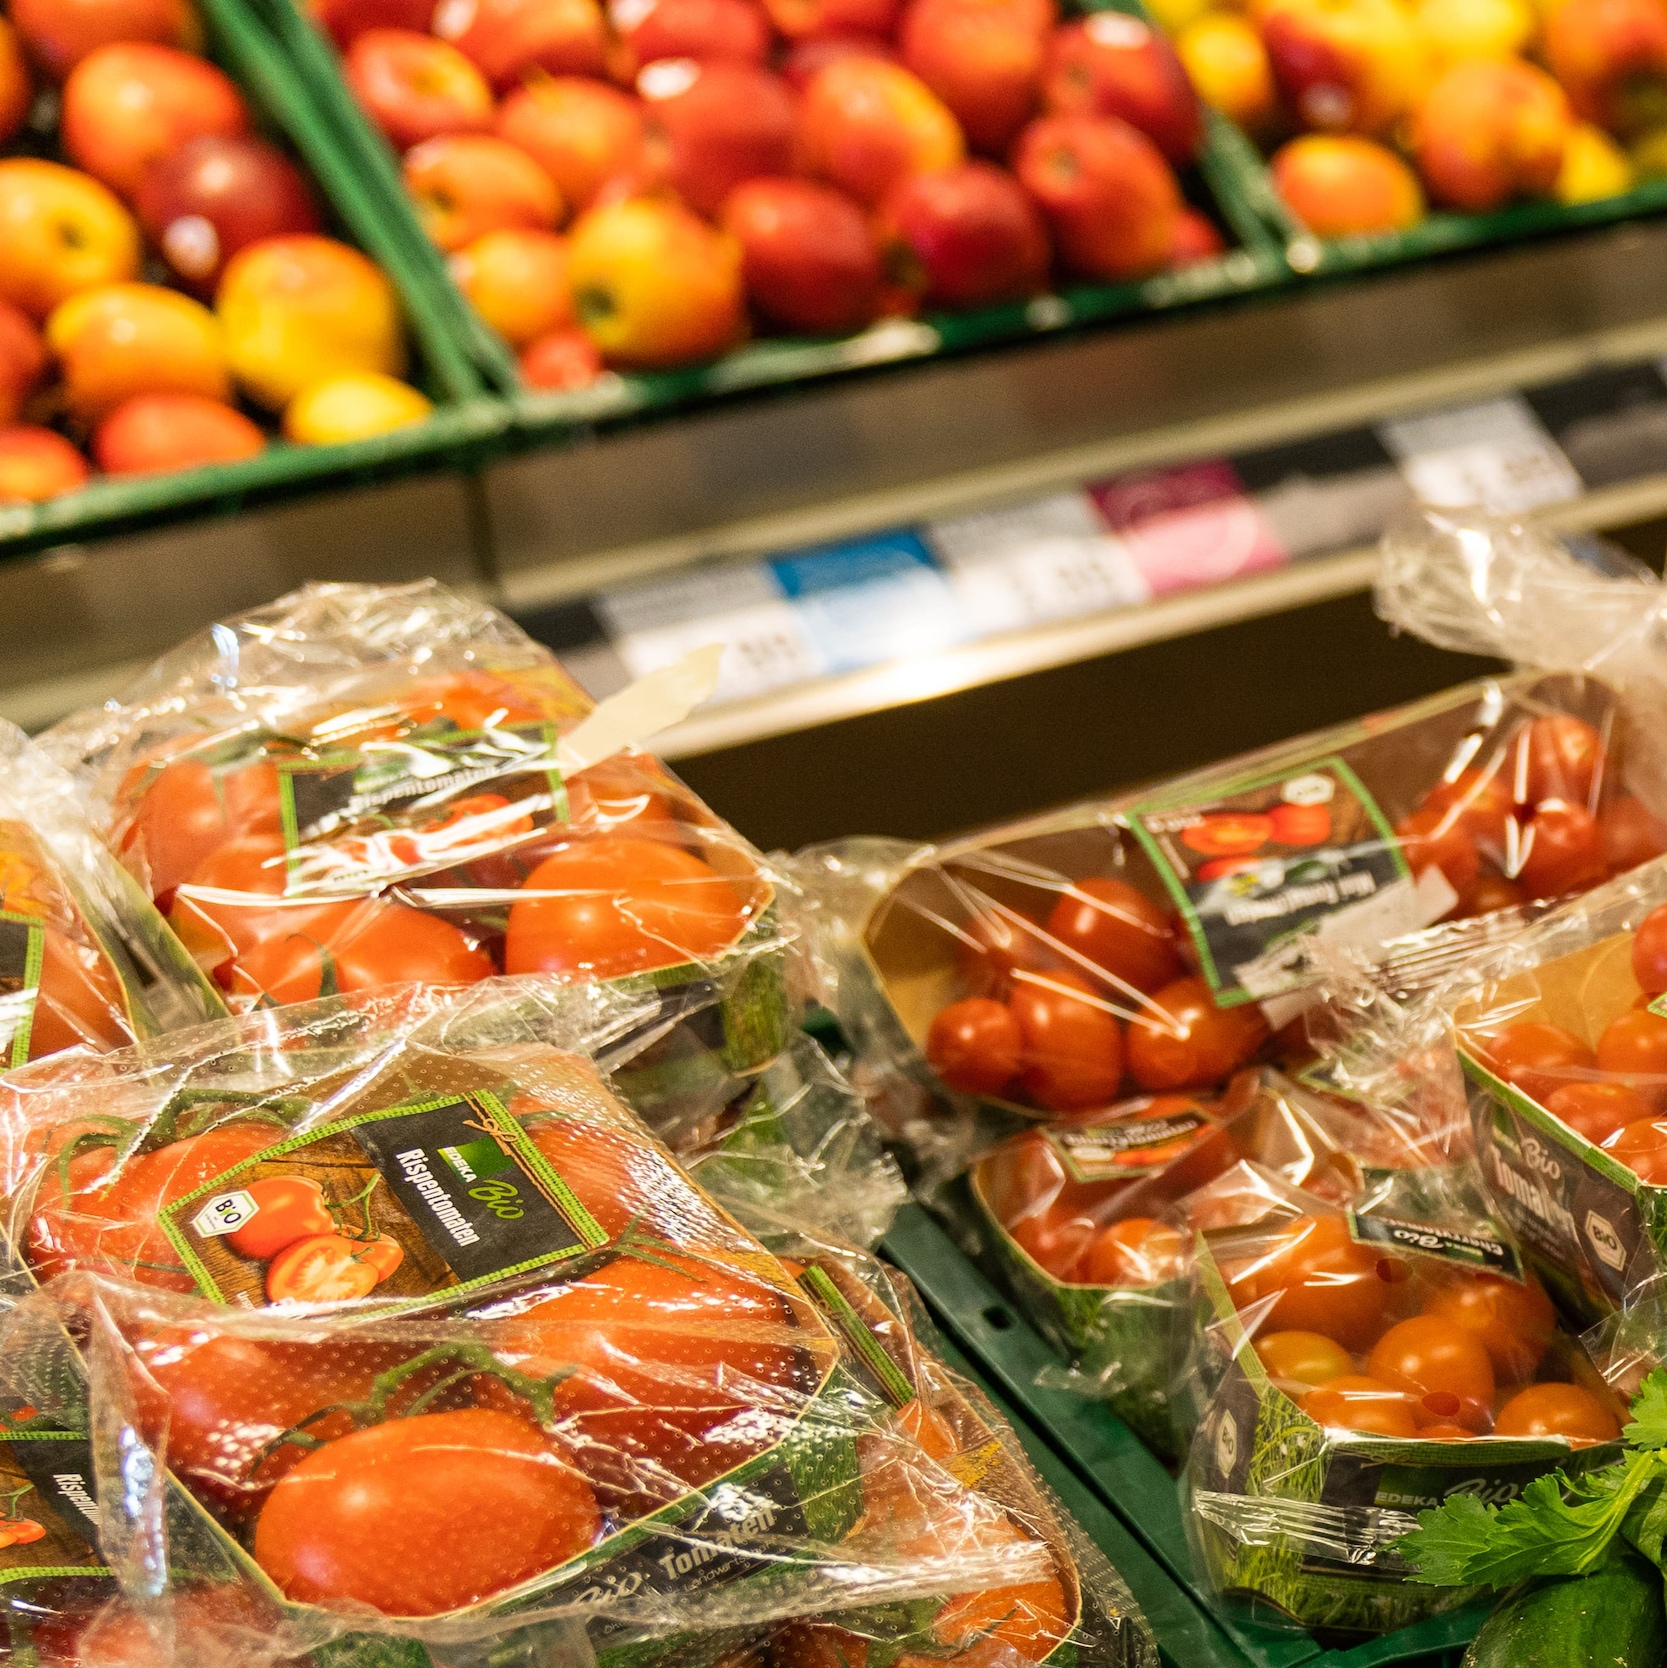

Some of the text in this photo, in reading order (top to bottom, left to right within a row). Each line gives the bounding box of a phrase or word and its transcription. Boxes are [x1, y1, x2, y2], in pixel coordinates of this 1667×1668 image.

[395, 1147, 482, 1248] Rispentomaten
[436, 1145, 526, 1221] EDEKA Bio
[1392, 1229, 1445, 1250] Bio
[1374, 1477, 1519, 1508] EDEKA Bio
[658, 1508, 777, 1581] Tomaten
